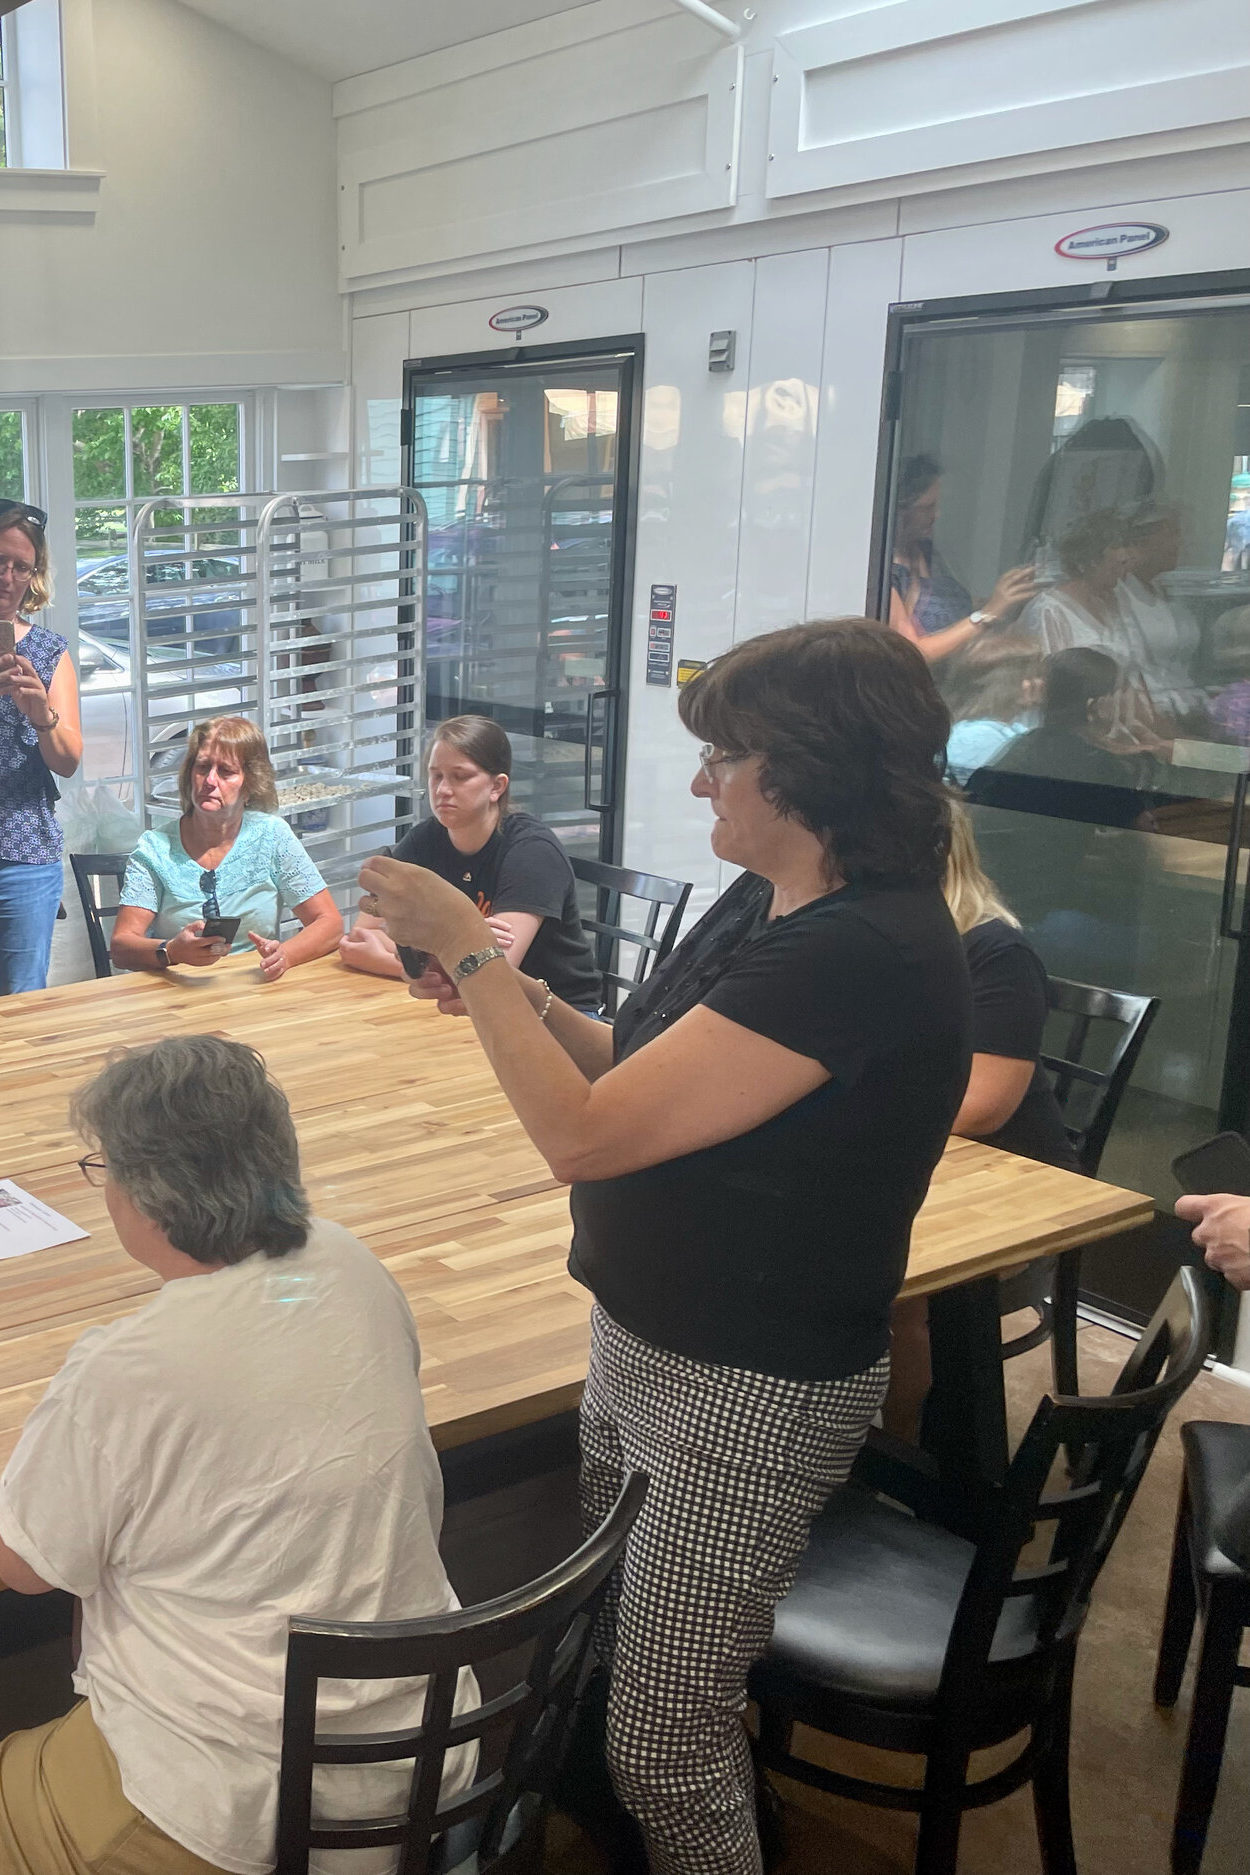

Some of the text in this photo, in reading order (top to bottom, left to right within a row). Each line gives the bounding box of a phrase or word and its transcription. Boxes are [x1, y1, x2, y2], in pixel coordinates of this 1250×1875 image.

[1068, 232, 1150, 250] American Panel
[496, 312, 538, 324] American Panel
